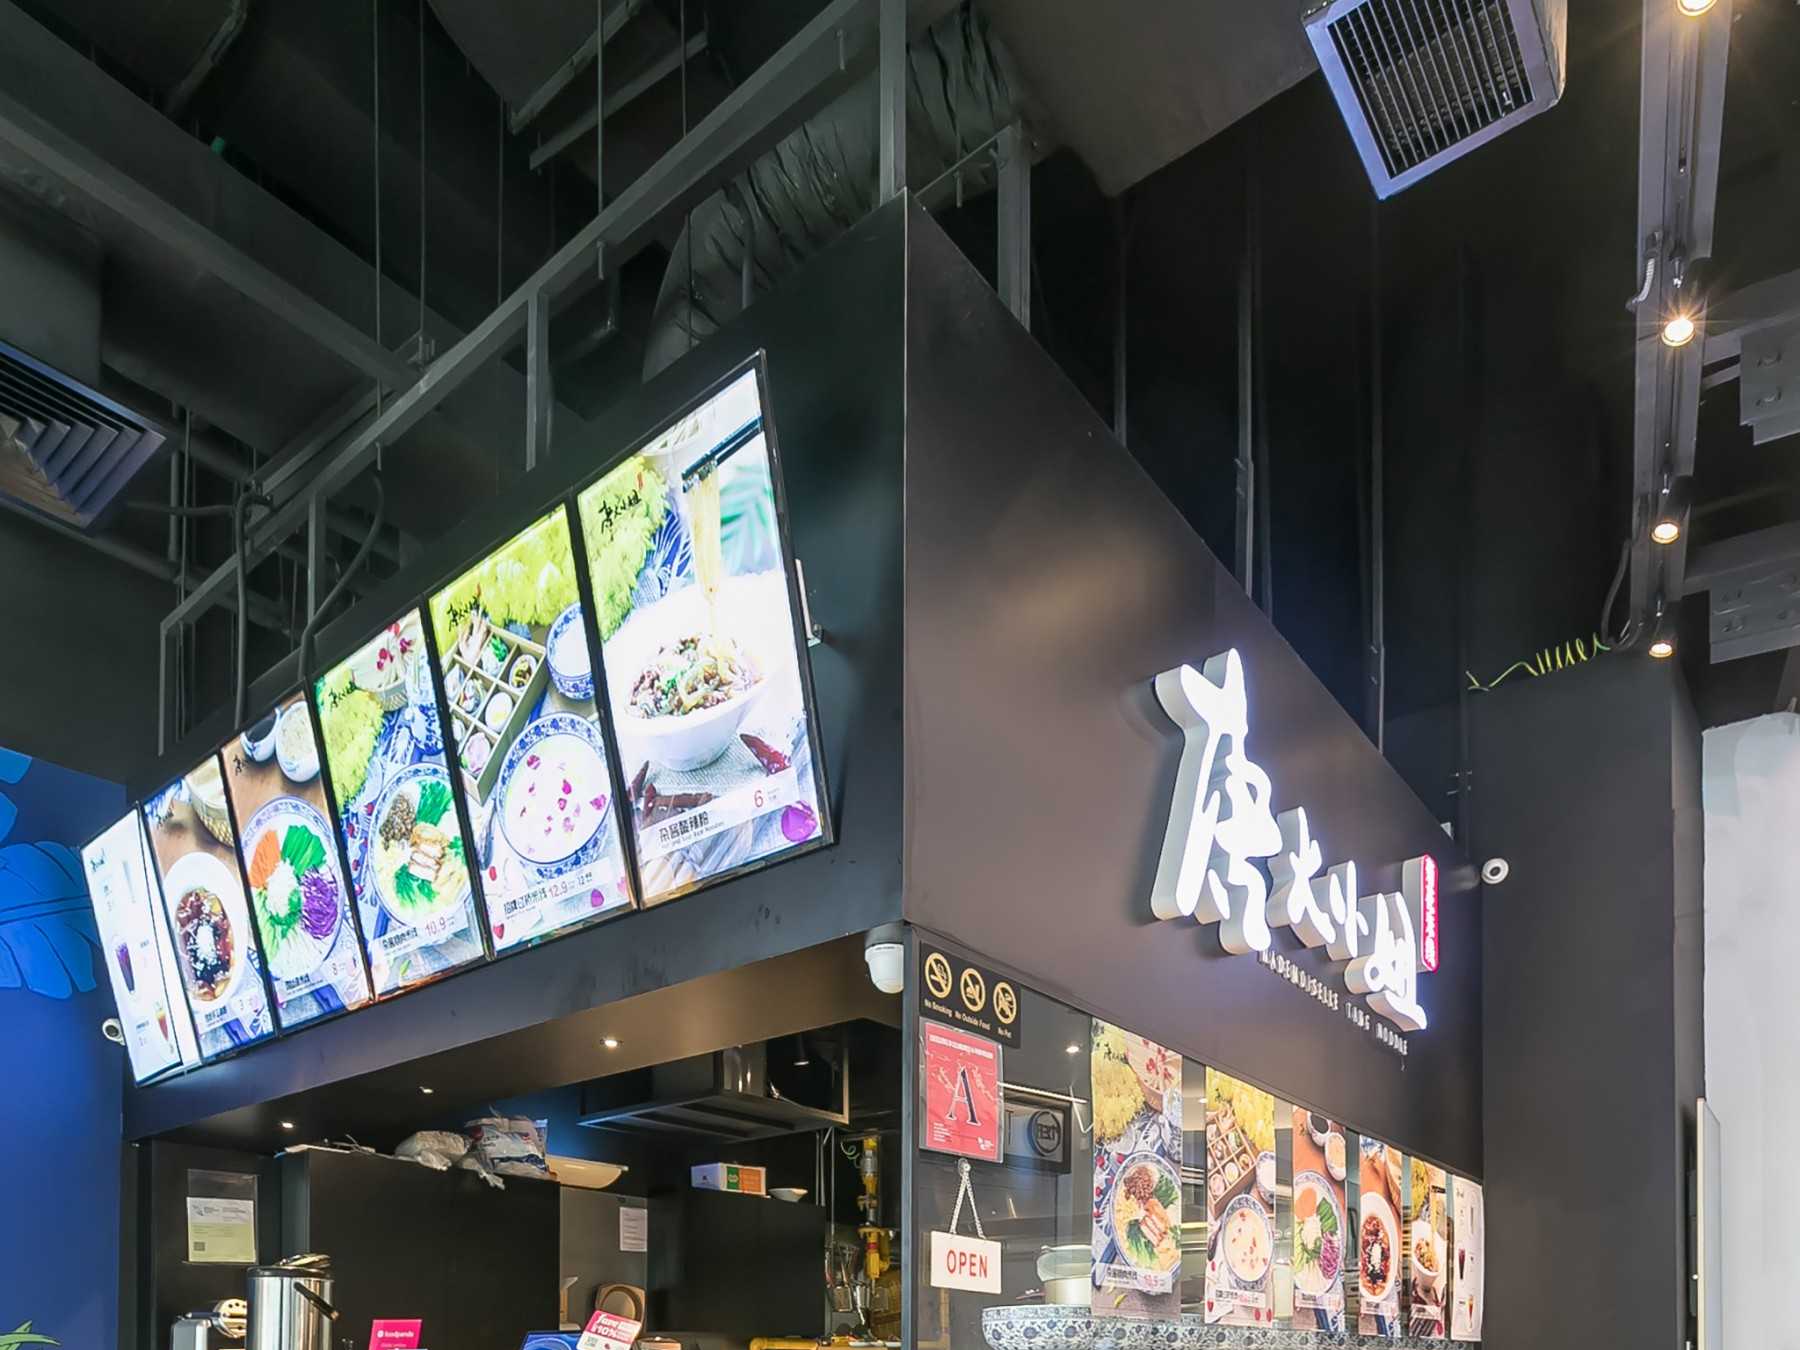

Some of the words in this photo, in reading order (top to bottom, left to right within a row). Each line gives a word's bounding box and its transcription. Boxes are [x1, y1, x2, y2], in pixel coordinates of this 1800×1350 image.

[754, 790, 764, 808] 6
[946, 1064, 981, 1126] A
[947, 1249, 988, 1279] OPEN
